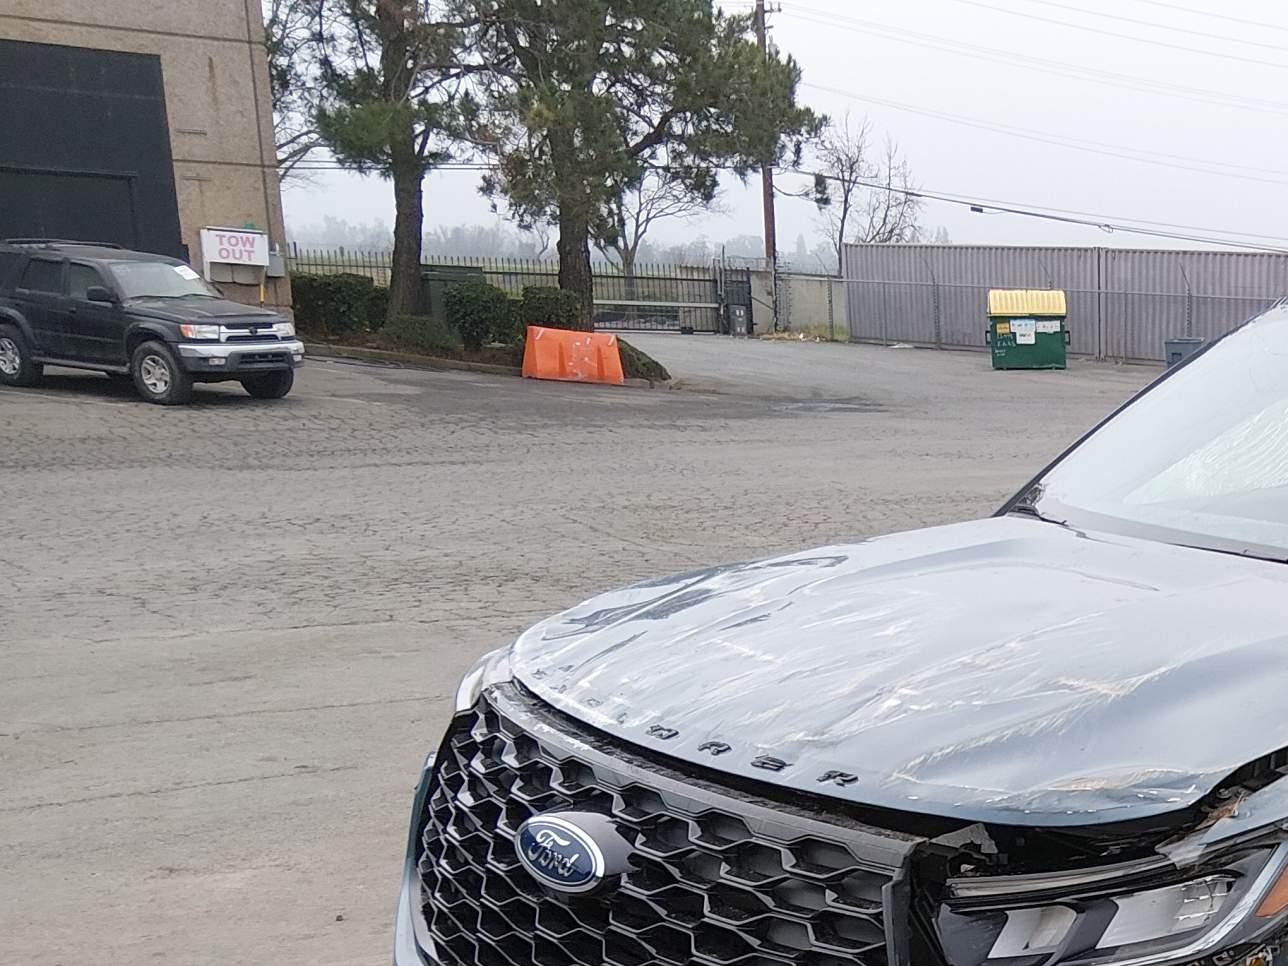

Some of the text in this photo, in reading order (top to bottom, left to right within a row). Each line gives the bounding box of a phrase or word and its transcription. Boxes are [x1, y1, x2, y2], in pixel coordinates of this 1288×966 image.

[215, 234, 255, 248] TOW
[218, 247, 255, 261] OUT
[527, 829, 580, 877] Ford
